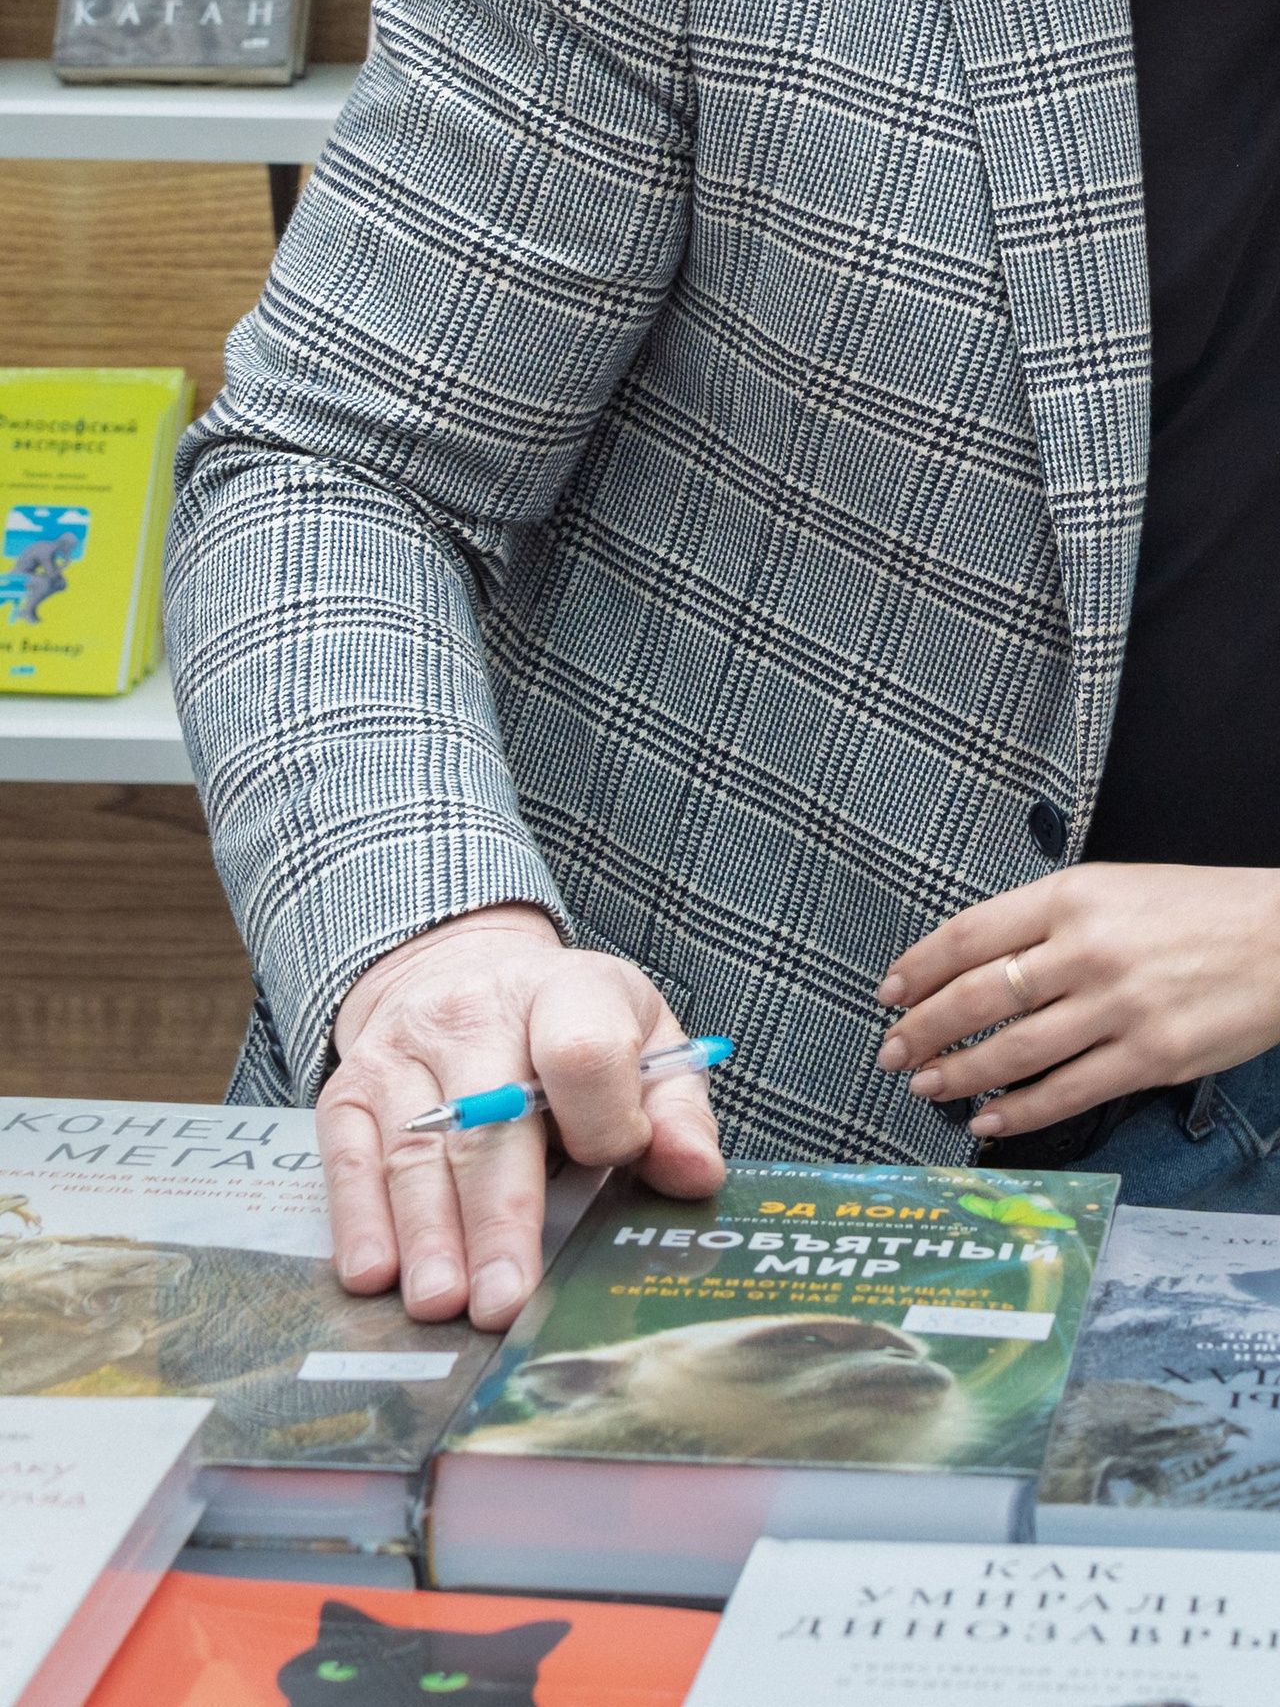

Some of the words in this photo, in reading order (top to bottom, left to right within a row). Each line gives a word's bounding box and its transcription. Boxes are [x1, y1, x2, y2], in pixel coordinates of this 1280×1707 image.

[73, 0, 275, 27] КАГАН
[2, 1112, 279, 1146] КОНЕЦ
[45, 1143, 322, 1172] МЕГАФ
[0, 1169, 134, 1183] ЕКАТЕЛЬНАЯ
[725, 1167, 822, 1179] СТСЕЛЛЕР
[874, 1174, 918, 1183] NEW
[926, 1175, 976, 1185] YORK
[759, 1200, 817, 1218] ЭД
[835, 1201, 951, 1221] ЙОНГ
[613, 1226, 1060, 1264] НЕОБЪЯТНЫЙ
[754, 1254, 901, 1279] МИР
[609, 1284, 737, 1299] СКРЫТУЮ
[746, 1291, 781, 1301] ОТ
[789, 1292, 840, 1304] НАС
[643, 1275, 692, 1286] КАК
[702, 1277, 845, 1292] ЖИВОТНЫЕ
[855, 1283, 993, 1299] ОЩУЩАЮТ
[983, 1559, 1124, 1581] КАК
[857, 1586, 1228, 1617] УМИРАЛИ
